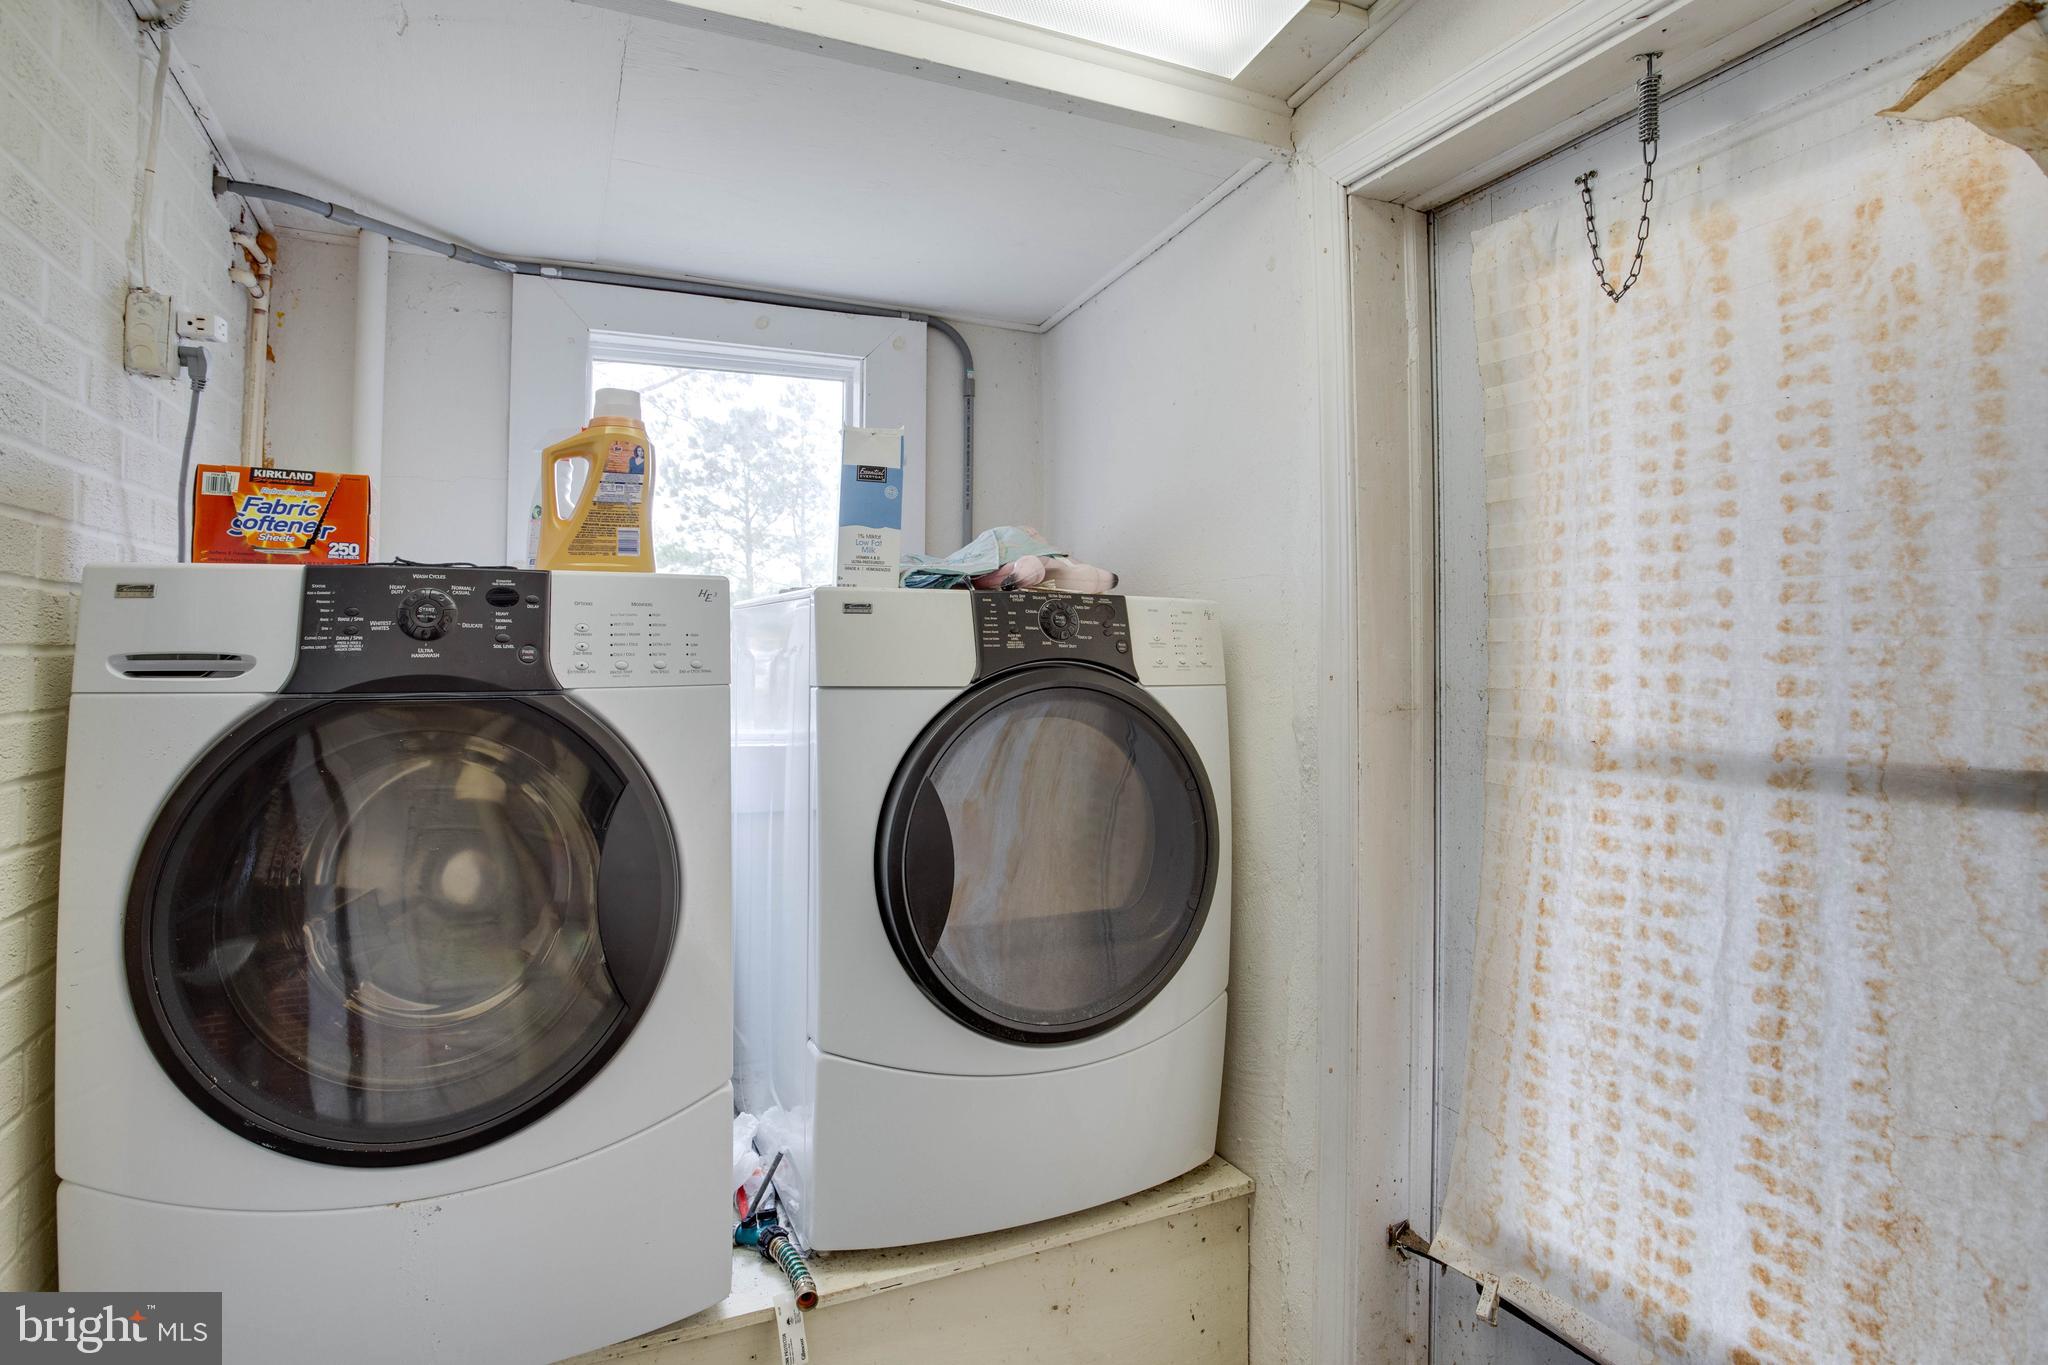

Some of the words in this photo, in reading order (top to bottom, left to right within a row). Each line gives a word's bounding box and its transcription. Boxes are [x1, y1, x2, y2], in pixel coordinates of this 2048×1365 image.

[253, 469, 314, 481] KIRKLAND
[241, 495, 321, 517] Fabric
[228, 512, 336, 540] Softener
[258, 532, 295, 543] Sheets
[328, 542, 360, 556] 250
[862, 546, 876, 554] Milk
